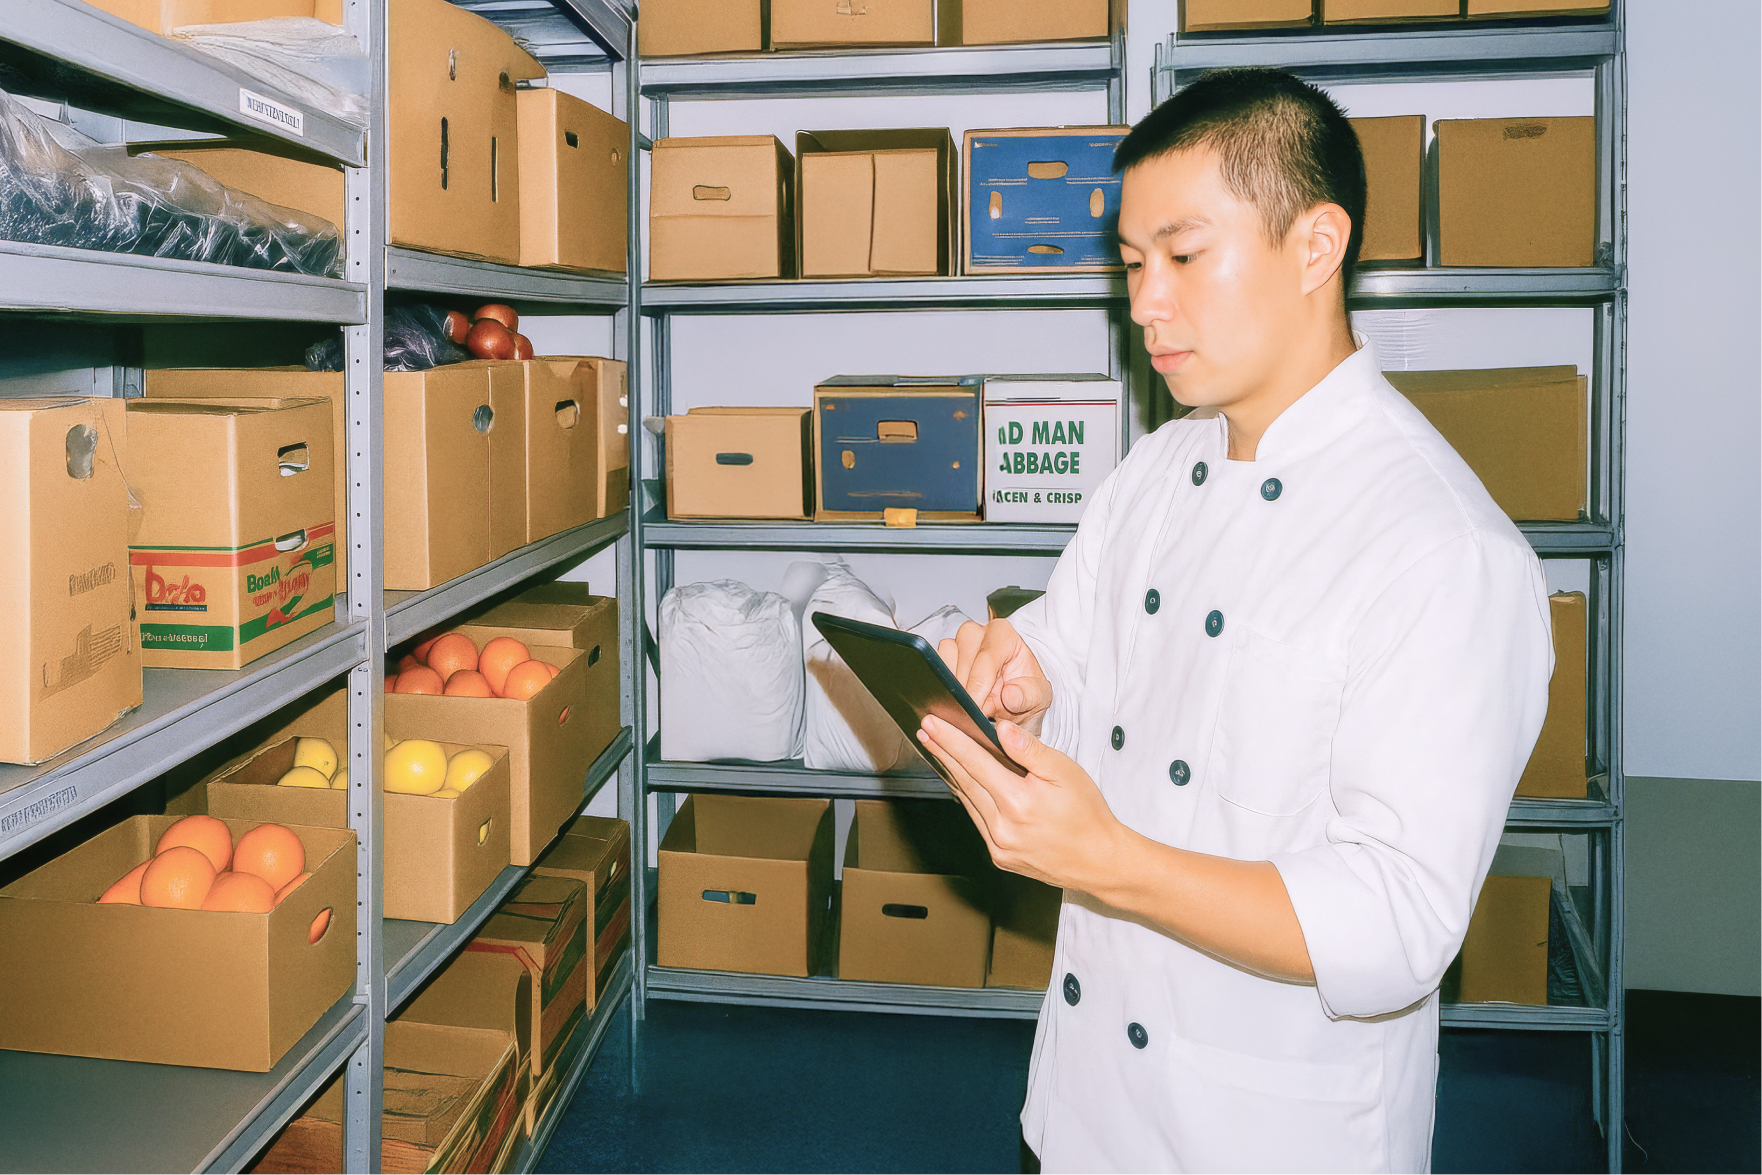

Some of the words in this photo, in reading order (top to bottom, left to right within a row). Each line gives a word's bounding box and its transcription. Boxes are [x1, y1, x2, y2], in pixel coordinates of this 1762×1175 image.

[1032, 421, 1084, 445] MAN
[999, 451, 1080, 474] ABBAGE
[1033, 493, 1042, 503] &
[1046, 492, 1082, 504] CRISP
